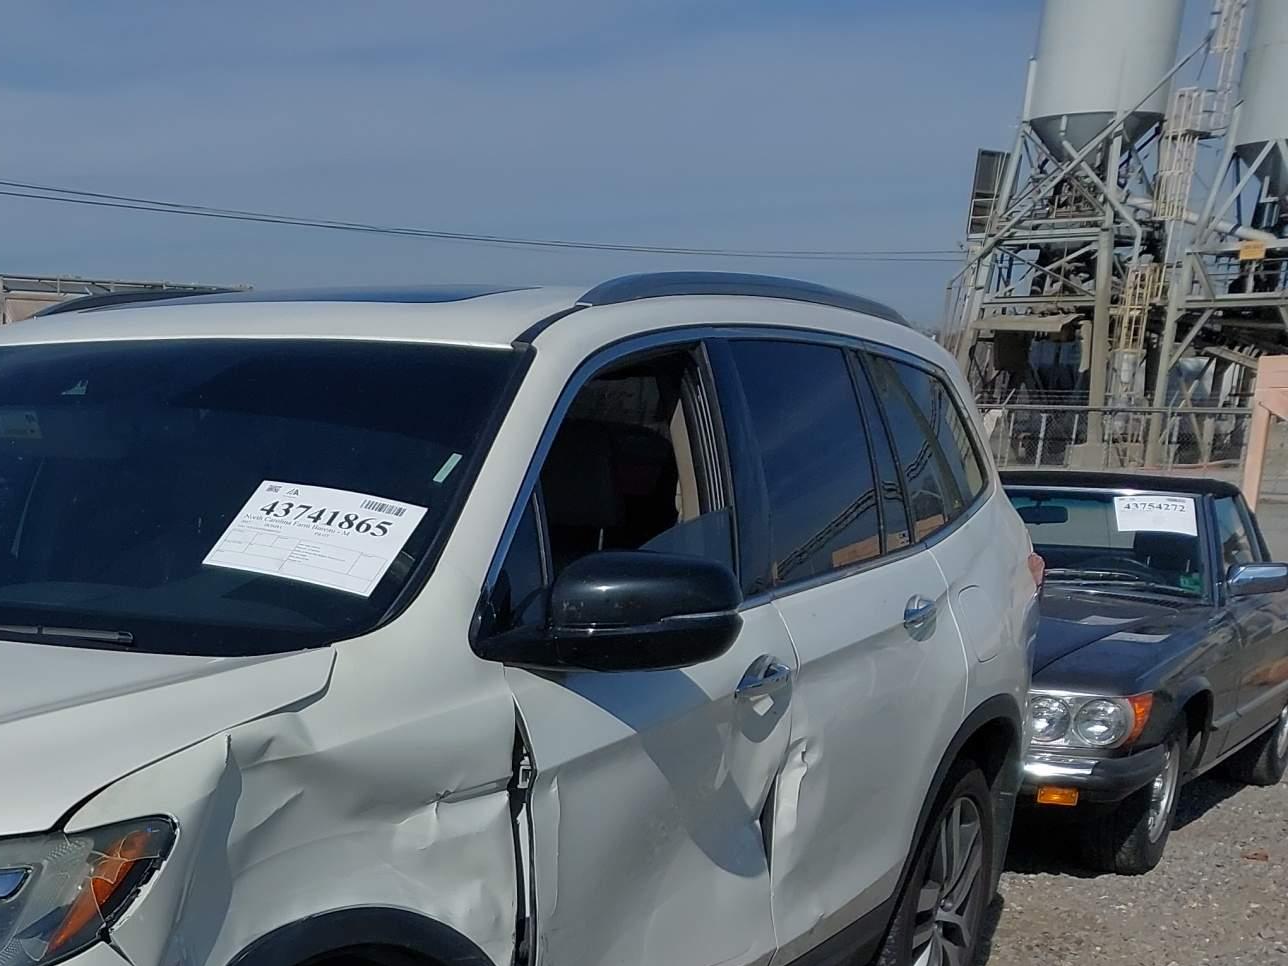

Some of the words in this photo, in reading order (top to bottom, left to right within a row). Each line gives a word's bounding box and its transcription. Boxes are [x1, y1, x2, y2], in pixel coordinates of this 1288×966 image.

[1123, 502, 1186, 513] 43754272
[244, 513, 264, 521] North
[264, 516, 292, 526] Carolina
[292, 521, 311, 529] Farm
[312, 525, 336, 534] Bureau
[259, 500, 393, 537] 43741865
